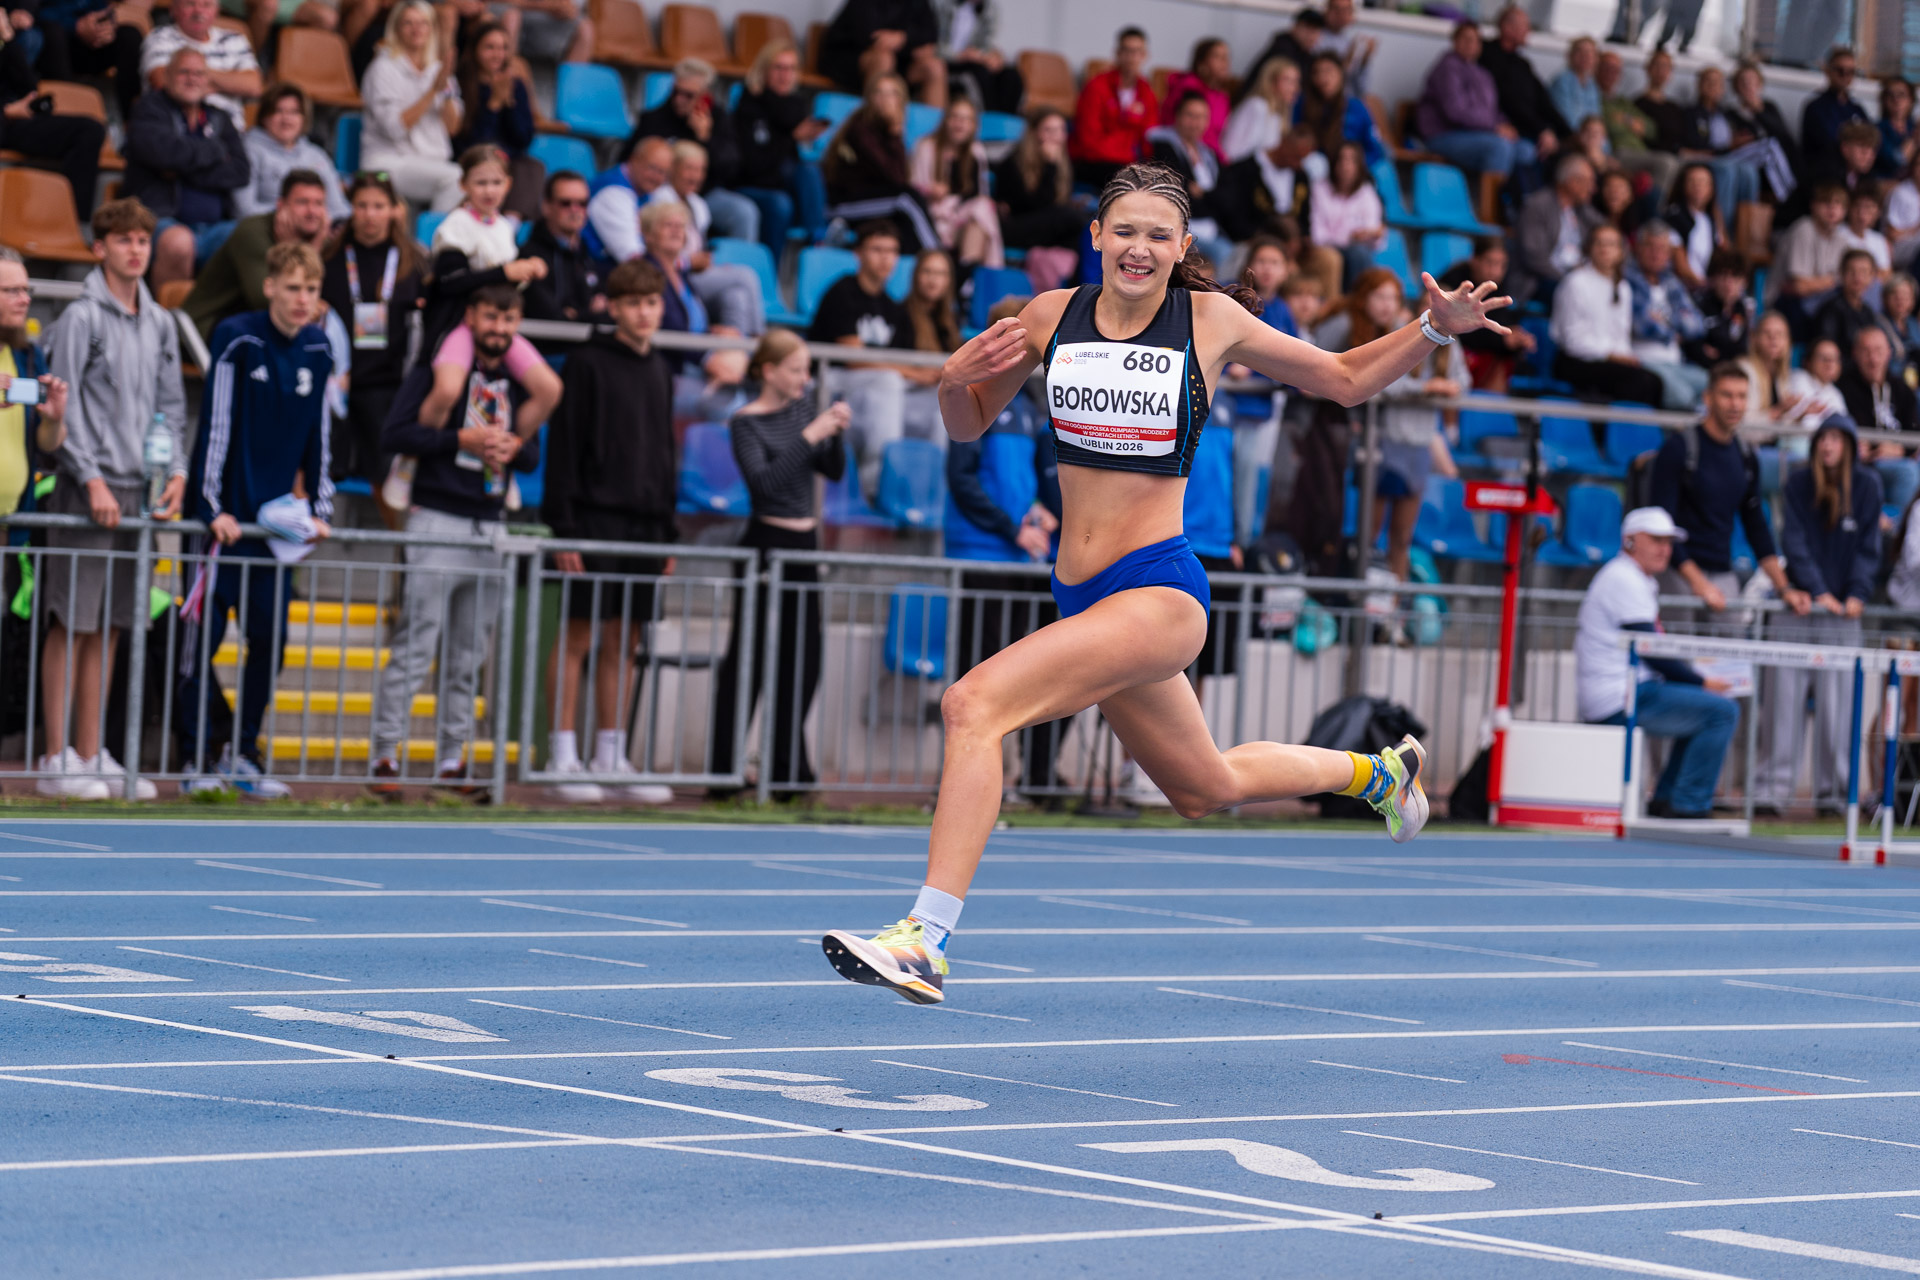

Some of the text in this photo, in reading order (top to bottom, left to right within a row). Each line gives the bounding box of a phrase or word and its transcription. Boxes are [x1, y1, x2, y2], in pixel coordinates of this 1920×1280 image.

[1075, 351, 1110, 359] LUBELSKIE
[1123, 350, 1171, 374] 680
[1052, 385, 1171, 417] BOROWSKA
[1069, 422, 1109, 432] OGÓLNOPOLSKA
[1109, 426, 1139, 434] OLIMPIADA
[1080, 437, 1144, 452] LUBLIN 2026
[230, 1005, 511, 1043] 4
[644, 1067, 989, 1112] 3
[1076, 1138, 1496, 1192] 2
